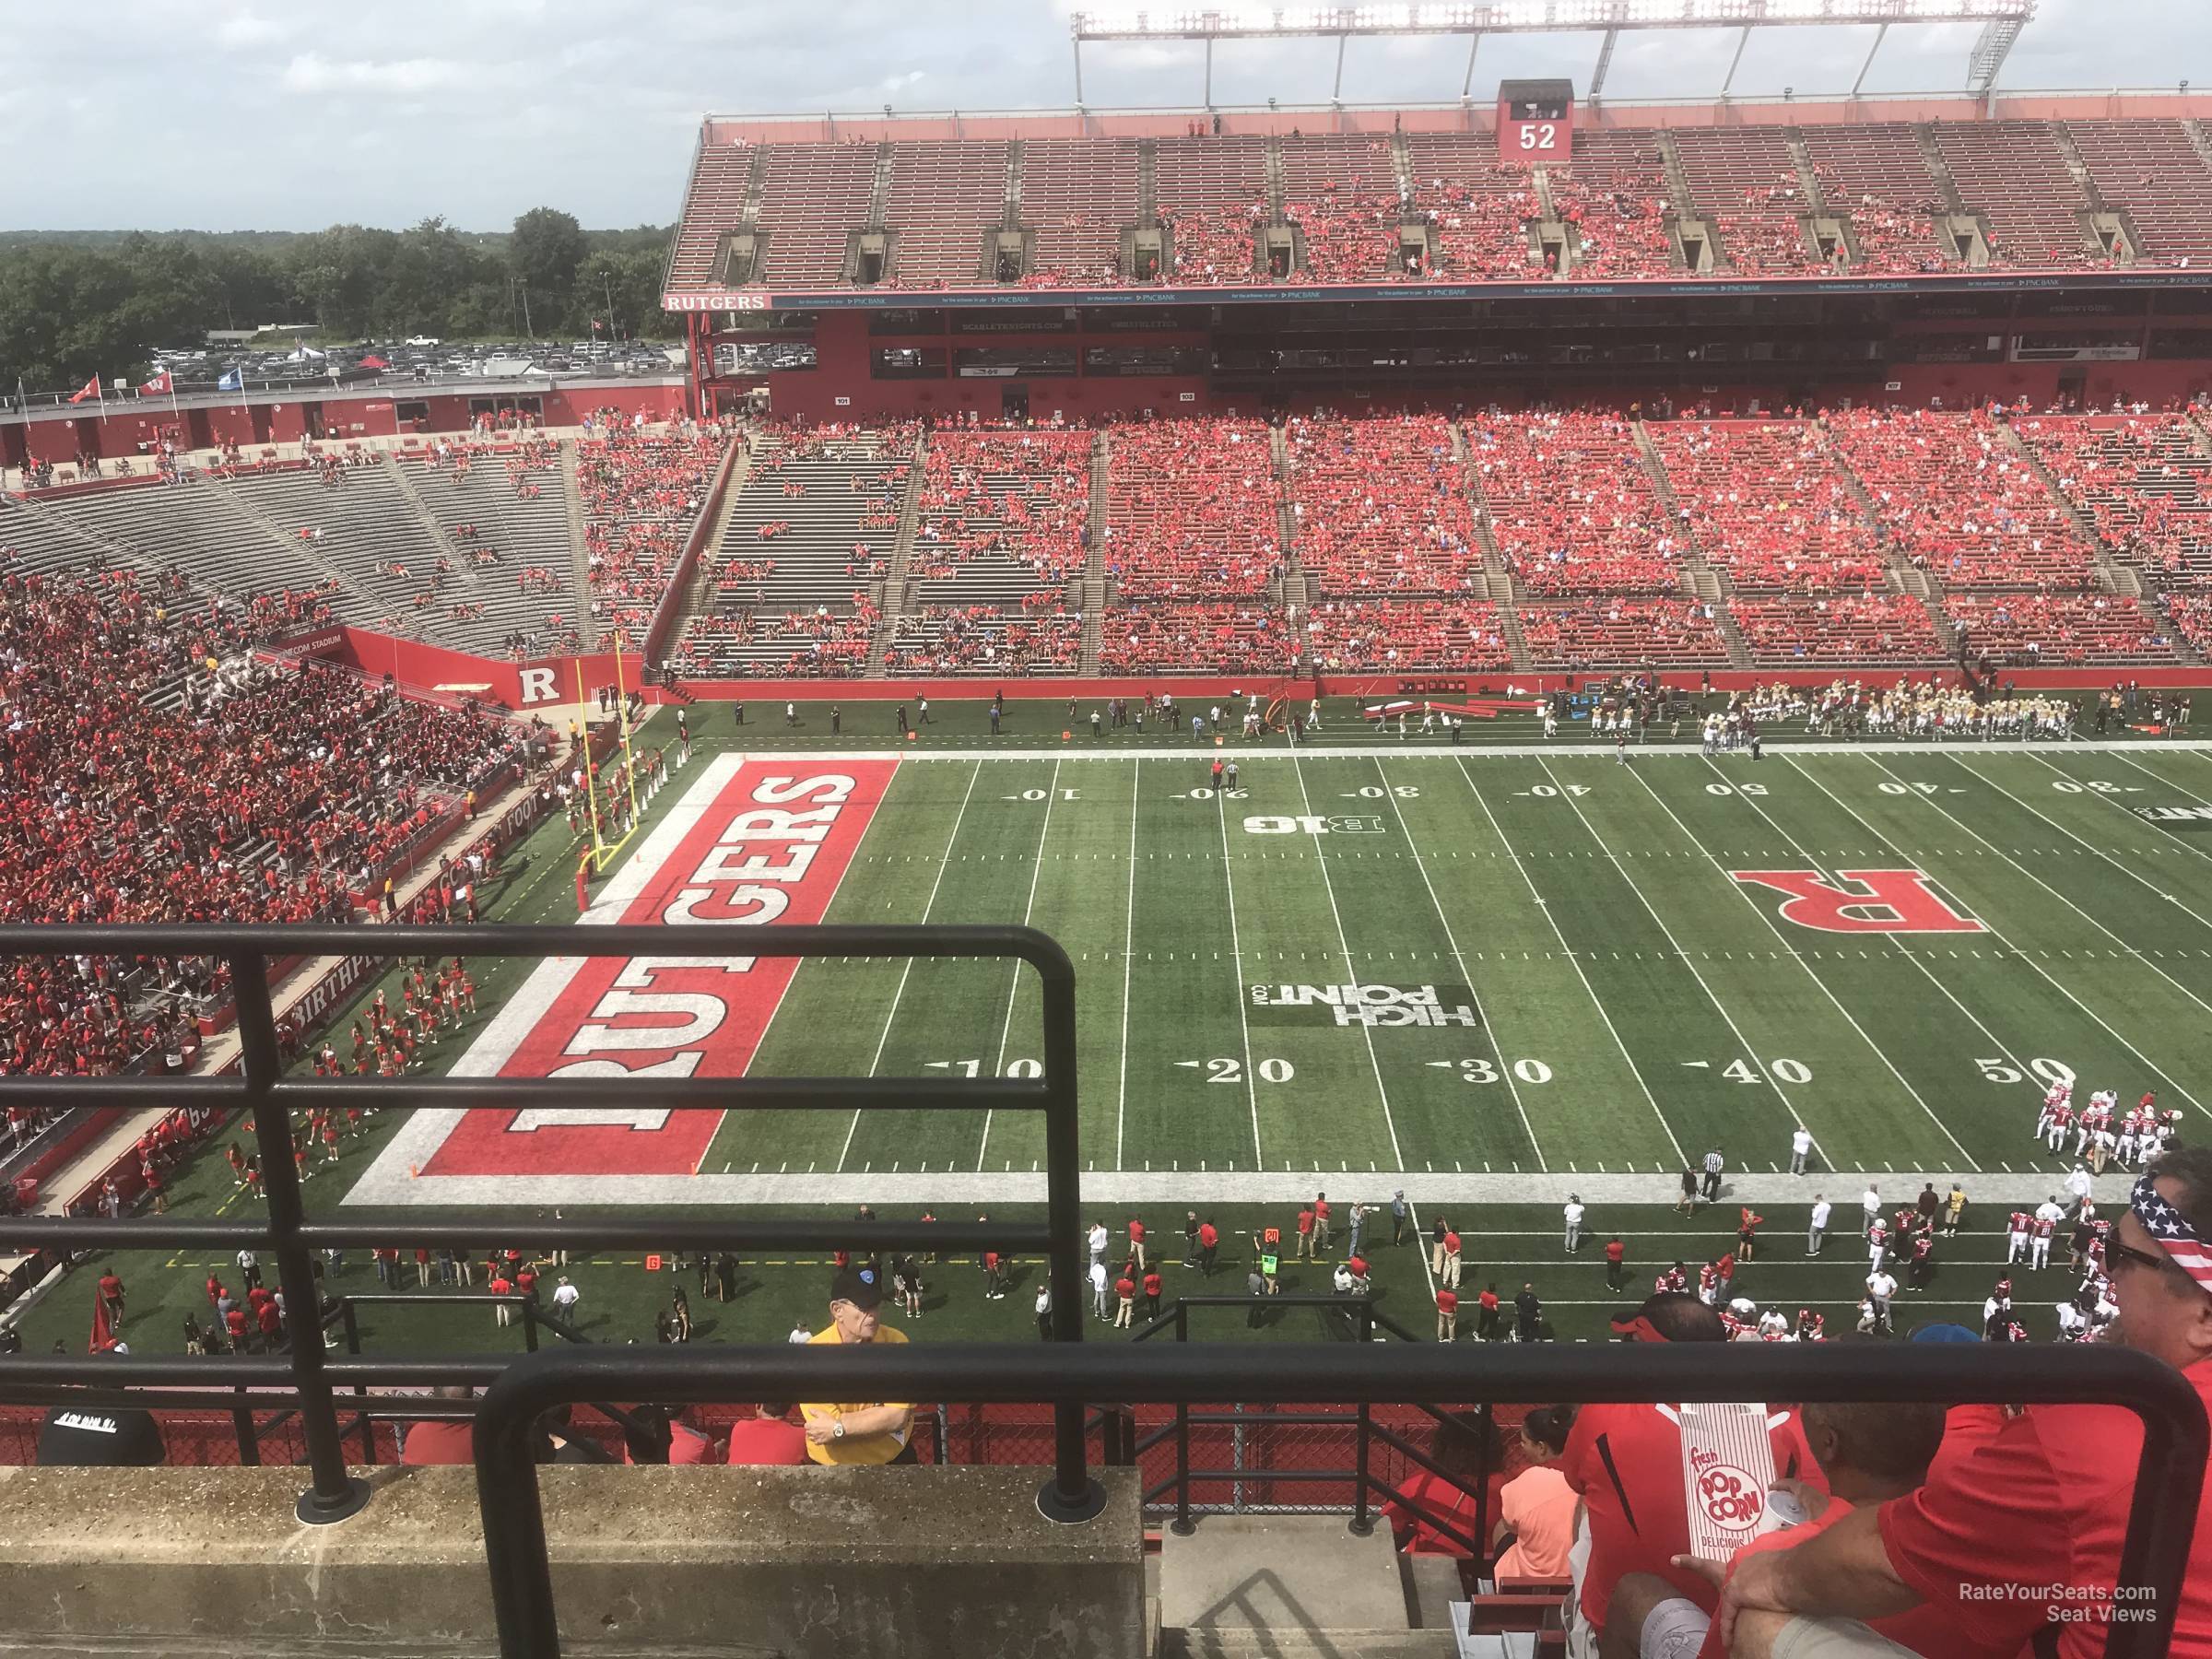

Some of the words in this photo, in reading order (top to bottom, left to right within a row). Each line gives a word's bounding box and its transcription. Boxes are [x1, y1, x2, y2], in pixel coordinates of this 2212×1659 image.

[1520, 124, 1556, 149] 52
[667, 296, 765, 311] RUTGERS
[312, 634, 342, 650] STADIUM
[519, 667, 560, 703] R
[1726, 869, 1991, 933] R
[505, 774, 857, 1132] RUTGERS
[1269, 984, 1439, 1006] POINT
[1333, 1005, 1477, 1027] HIGH
[956, 1059, 1042, 1078] 10
[1206, 1058, 1295, 1083] 20
[1459, 1058, 1553, 1084] 30
[1722, 1058, 1813, 1084] 40
[1973, 1057, 2077, 1085] 50
[1690, 1446, 1719, 1473] fresh
[1700, 1471, 1742, 1500] POP
[1708, 1490, 1761, 1522] CORN
[1700, 1535, 1745, 1549] DELICIOUS
